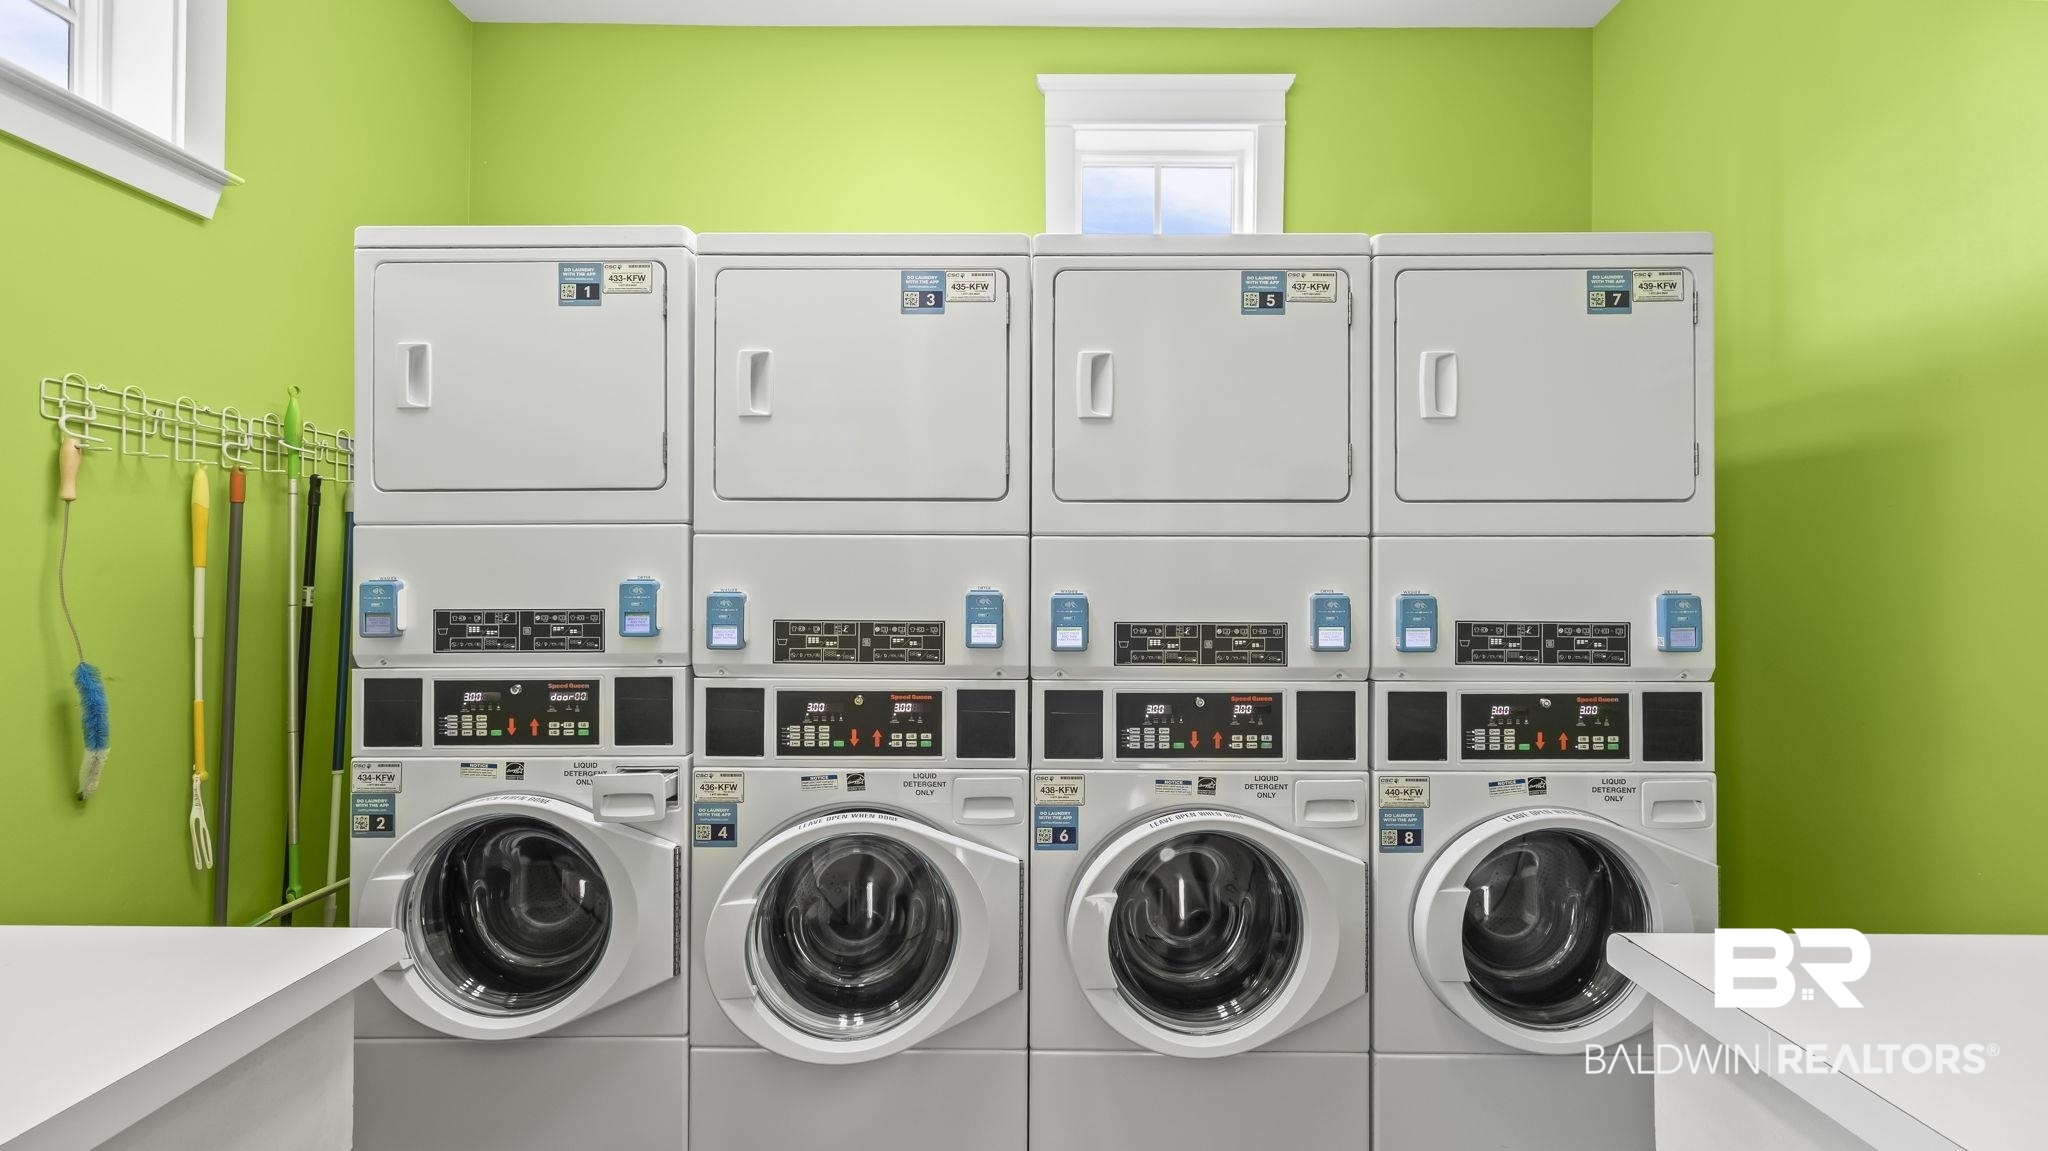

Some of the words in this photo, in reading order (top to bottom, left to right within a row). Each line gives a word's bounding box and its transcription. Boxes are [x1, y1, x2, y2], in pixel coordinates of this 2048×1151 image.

[609, 274, 646, 282] 433-KFW
[951, 283, 989, 291] 435-KFW
[1291, 283, 1330, 291] 437-KFW
[1638, 282, 1677, 290] 439-KFW
[584, 285, 590, 298] 1
[926, 293, 935, 306] 3
[1266, 294, 1276, 307] 5
[1612, 293, 1622, 306] 7
[463, 692, 482, 702] 3.00
[806, 702, 825, 712] 3.00
[894, 702, 912, 712] 3.00
[1146, 704, 1165, 714] 3.00
[1234, 704, 1252, 714] 3.00
[1491, 706, 1510, 715] 3.00
[1579, 705, 1598, 715] 3.00
[1040, 786, 1079, 794] 438-KFW
[1385, 788, 1424, 796] 440-KFW
[376, 816, 386, 830] 2
[826, 814, 848, 822] OPEN
[878, 814, 898, 822] DONE
[1149, 816, 1173, 829] LEAVE
[1175, 812, 1197, 820] OPEN
[717, 826, 728, 839] 4
[1059, 829, 1069, 842] 6
[1404, 831, 1414, 844] 8
